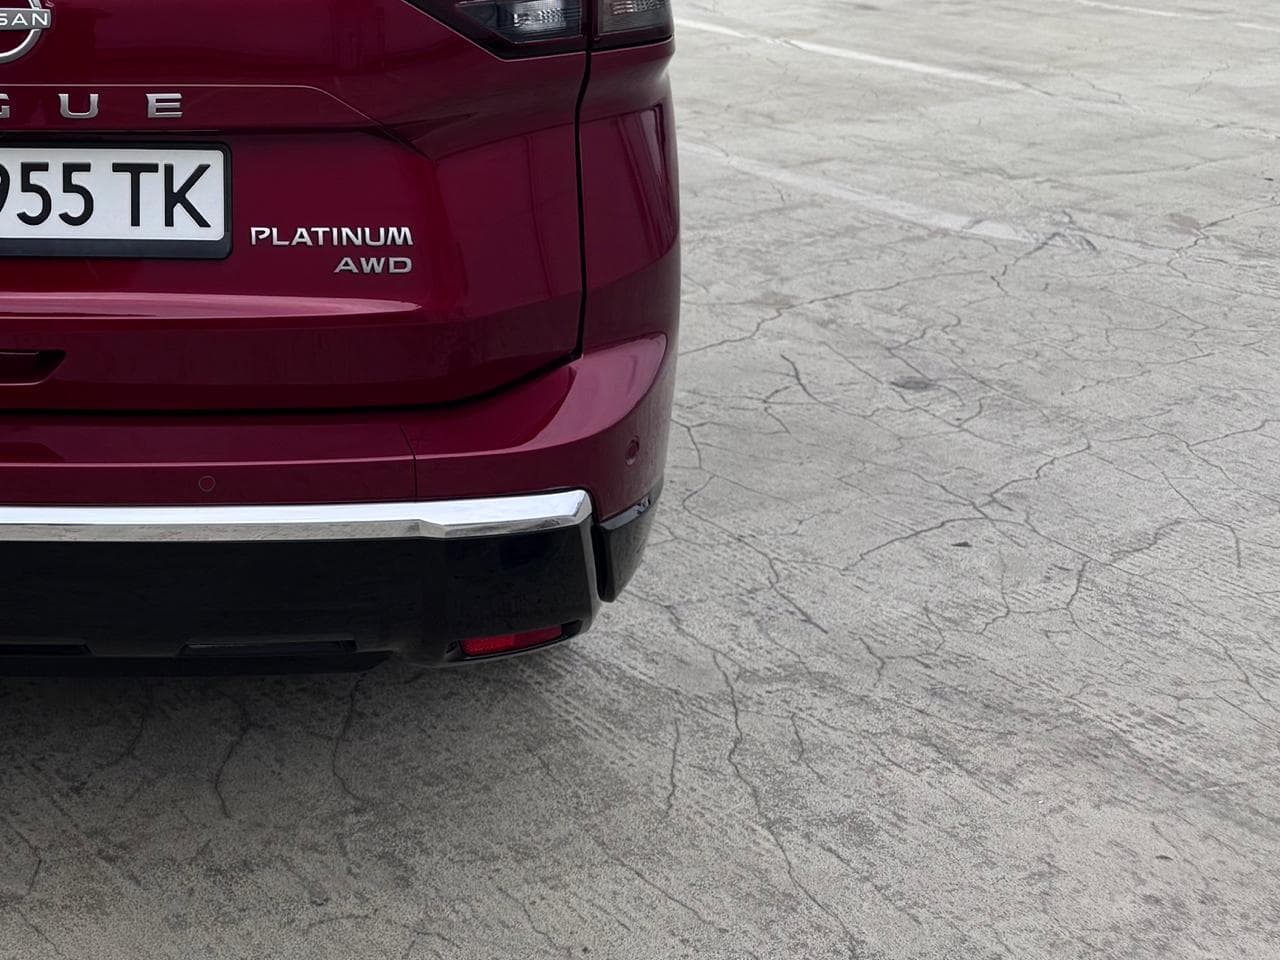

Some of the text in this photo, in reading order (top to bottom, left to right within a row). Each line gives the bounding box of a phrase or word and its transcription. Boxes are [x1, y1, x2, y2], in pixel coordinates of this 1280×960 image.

[111, 162, 212, 228] TK
[250, 226, 414, 246] PLATINUM
[333, 257, 412, 274] AWD
